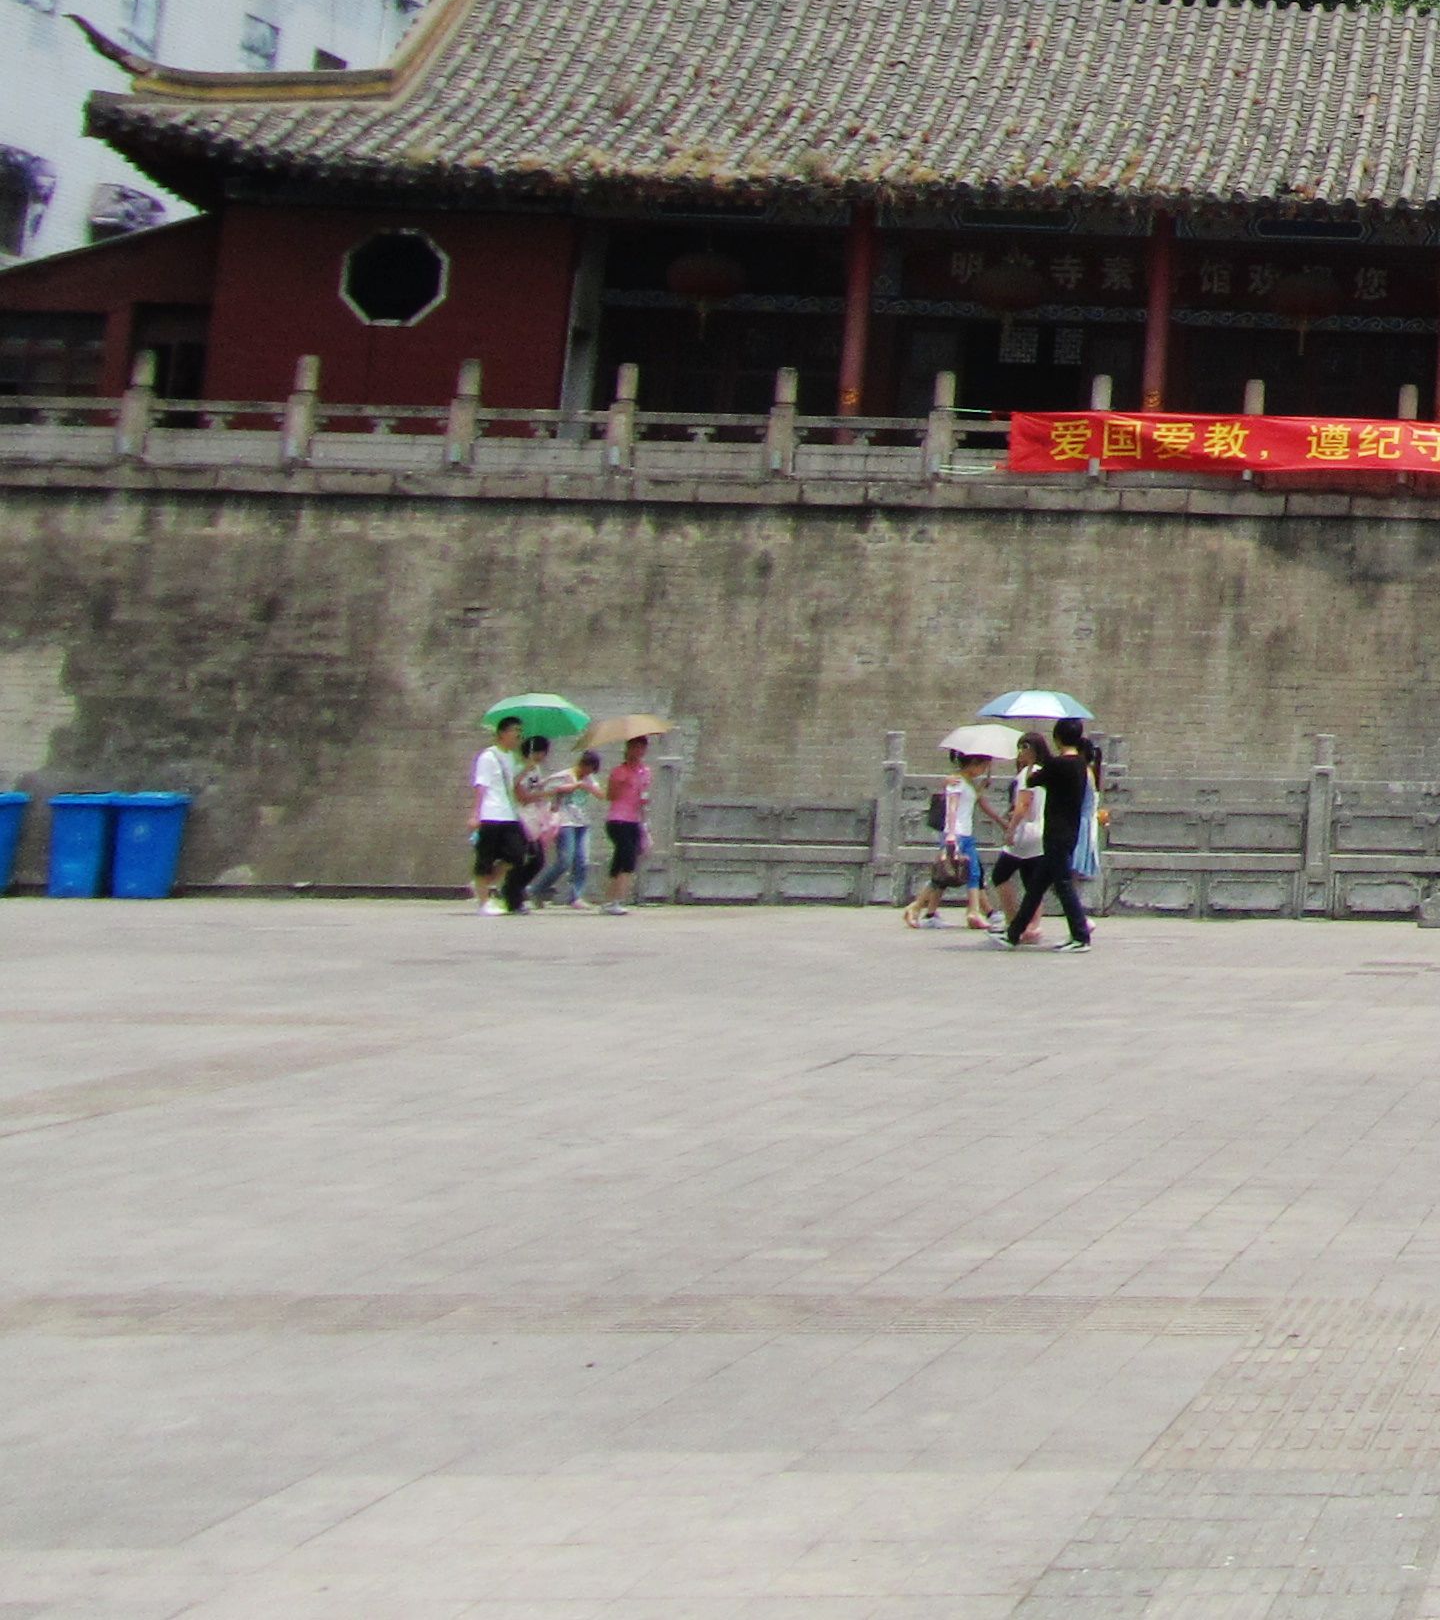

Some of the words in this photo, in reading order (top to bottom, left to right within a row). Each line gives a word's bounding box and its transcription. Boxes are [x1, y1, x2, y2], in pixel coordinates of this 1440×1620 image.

[950, 247, 1388, 300] 明寺素馆欢您
